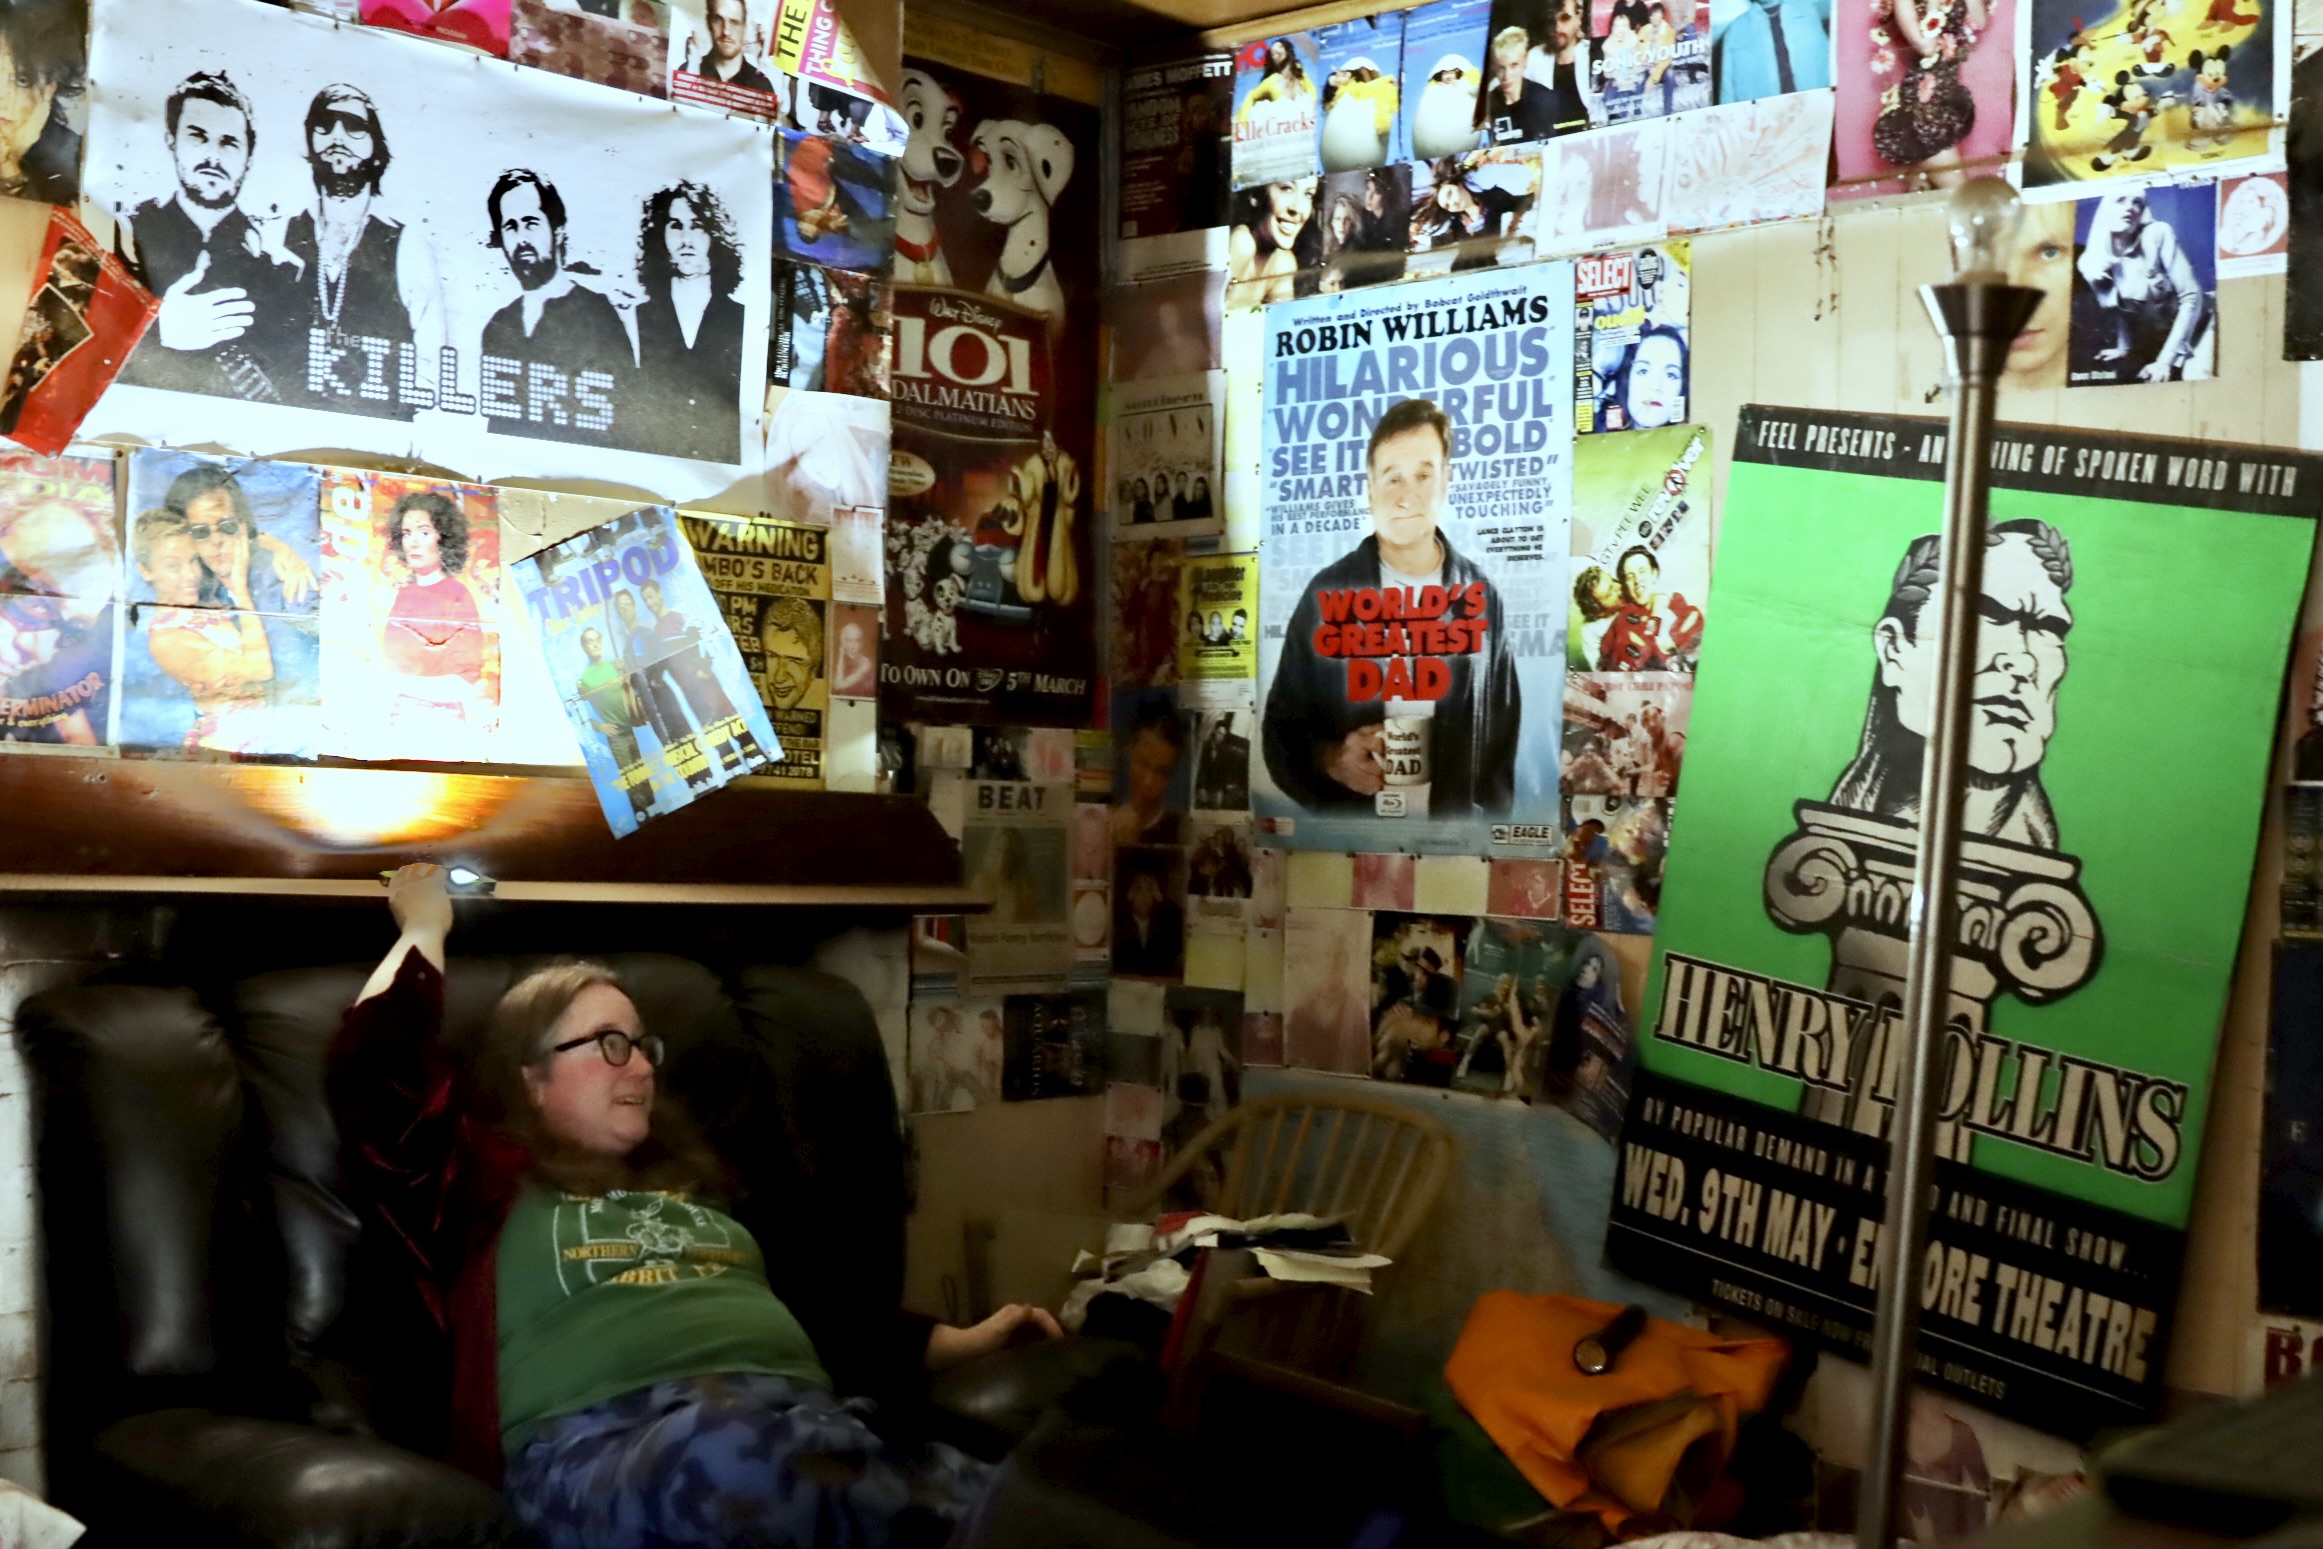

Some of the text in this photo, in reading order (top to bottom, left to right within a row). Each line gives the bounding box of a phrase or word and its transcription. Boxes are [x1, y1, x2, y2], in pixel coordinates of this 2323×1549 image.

[776, 5, 806, 58] THE
[805, 16, 834, 74] THING
[1591, 38, 1706, 75] SONIC YOUTH
[1234, 112, 1316, 142] Elle Cracks
[1577, 256, 1632, 294] SELECT
[1276, 320, 1373, 358] ROBIN
[1382, 295, 1549, 343] WILLIAMS
[1292, 285, 1528, 327] Written and Directed by Bobcat Goldthwait
[890, 316, 1040, 397] 101
[307, 327, 615, 432] KILLERS
[892, 379, 1037, 421] DALMATIANS
[1335, 439, 1365, 473] IT
[1757, 420, 1798, 450] FEEL
[1804, 424, 1896, 460] PRESENTS
[1918, 434, 1945, 464] AN
[2041, 445, 2069, 475] OF
[2074, 448, 2159, 484] SPOKEN
[2166, 455, 2228, 491] WORD
[2238, 462, 2298, 497] WITH
[1324, 499, 1355, 512] GIVES
[1448, 487, 1552, 505] UNEXPECTEDLY
[684, 518, 819, 560] WARNING
[1271, 523, 1285, 536] IN
[1290, 522, 1300, 535] A
[527, 535, 680, 622] TRIPOD
[771, 562, 818, 585] BACK
[731, 596, 757, 616] PM
[1317, 582, 1488, 622] WORLD'S
[1313, 619, 1490, 658] GREATEST
[903, 665, 942, 687] OWN
[946, 668, 970, 688] ON
[1034, 674, 1086, 695] MARCH
[1347, 656, 1452, 703] DAD
[783, 751, 819, 765] OTEL
[1385, 759, 1422, 776] DAD
[978, 786, 1046, 810] BEAT
[1513, 826, 1549, 839] EAGLE
[1569, 862, 1597, 927] SELECT
[1653, 951, 1872, 1094] HENRY
[1641, 1096, 1665, 1126] BY
[1670, 1104, 1748, 1152] POPULAR
[1753, 1130, 1829, 1177] DEMAND
[1833, 1154, 1857, 1188] IN
[1861, 1163, 1875, 1194] A
[1947, 1190, 1988, 1228] AND
[1994, 1204, 2057, 1250] FINAL
[1621, 1141, 1691, 1227] WED.
[1698, 1167, 1764, 1249] 9TH
[1761, 1188, 1838, 1273] MAY
[1991, 1261, 2159, 1386] THEATRE
[1711, 1277, 1763, 1312] TICKETS
[1764, 1298, 1784, 1320] ON
[1785, 1305, 1820, 1331] SALE
[1943, 1361, 2008, 1402] OUTLETS
